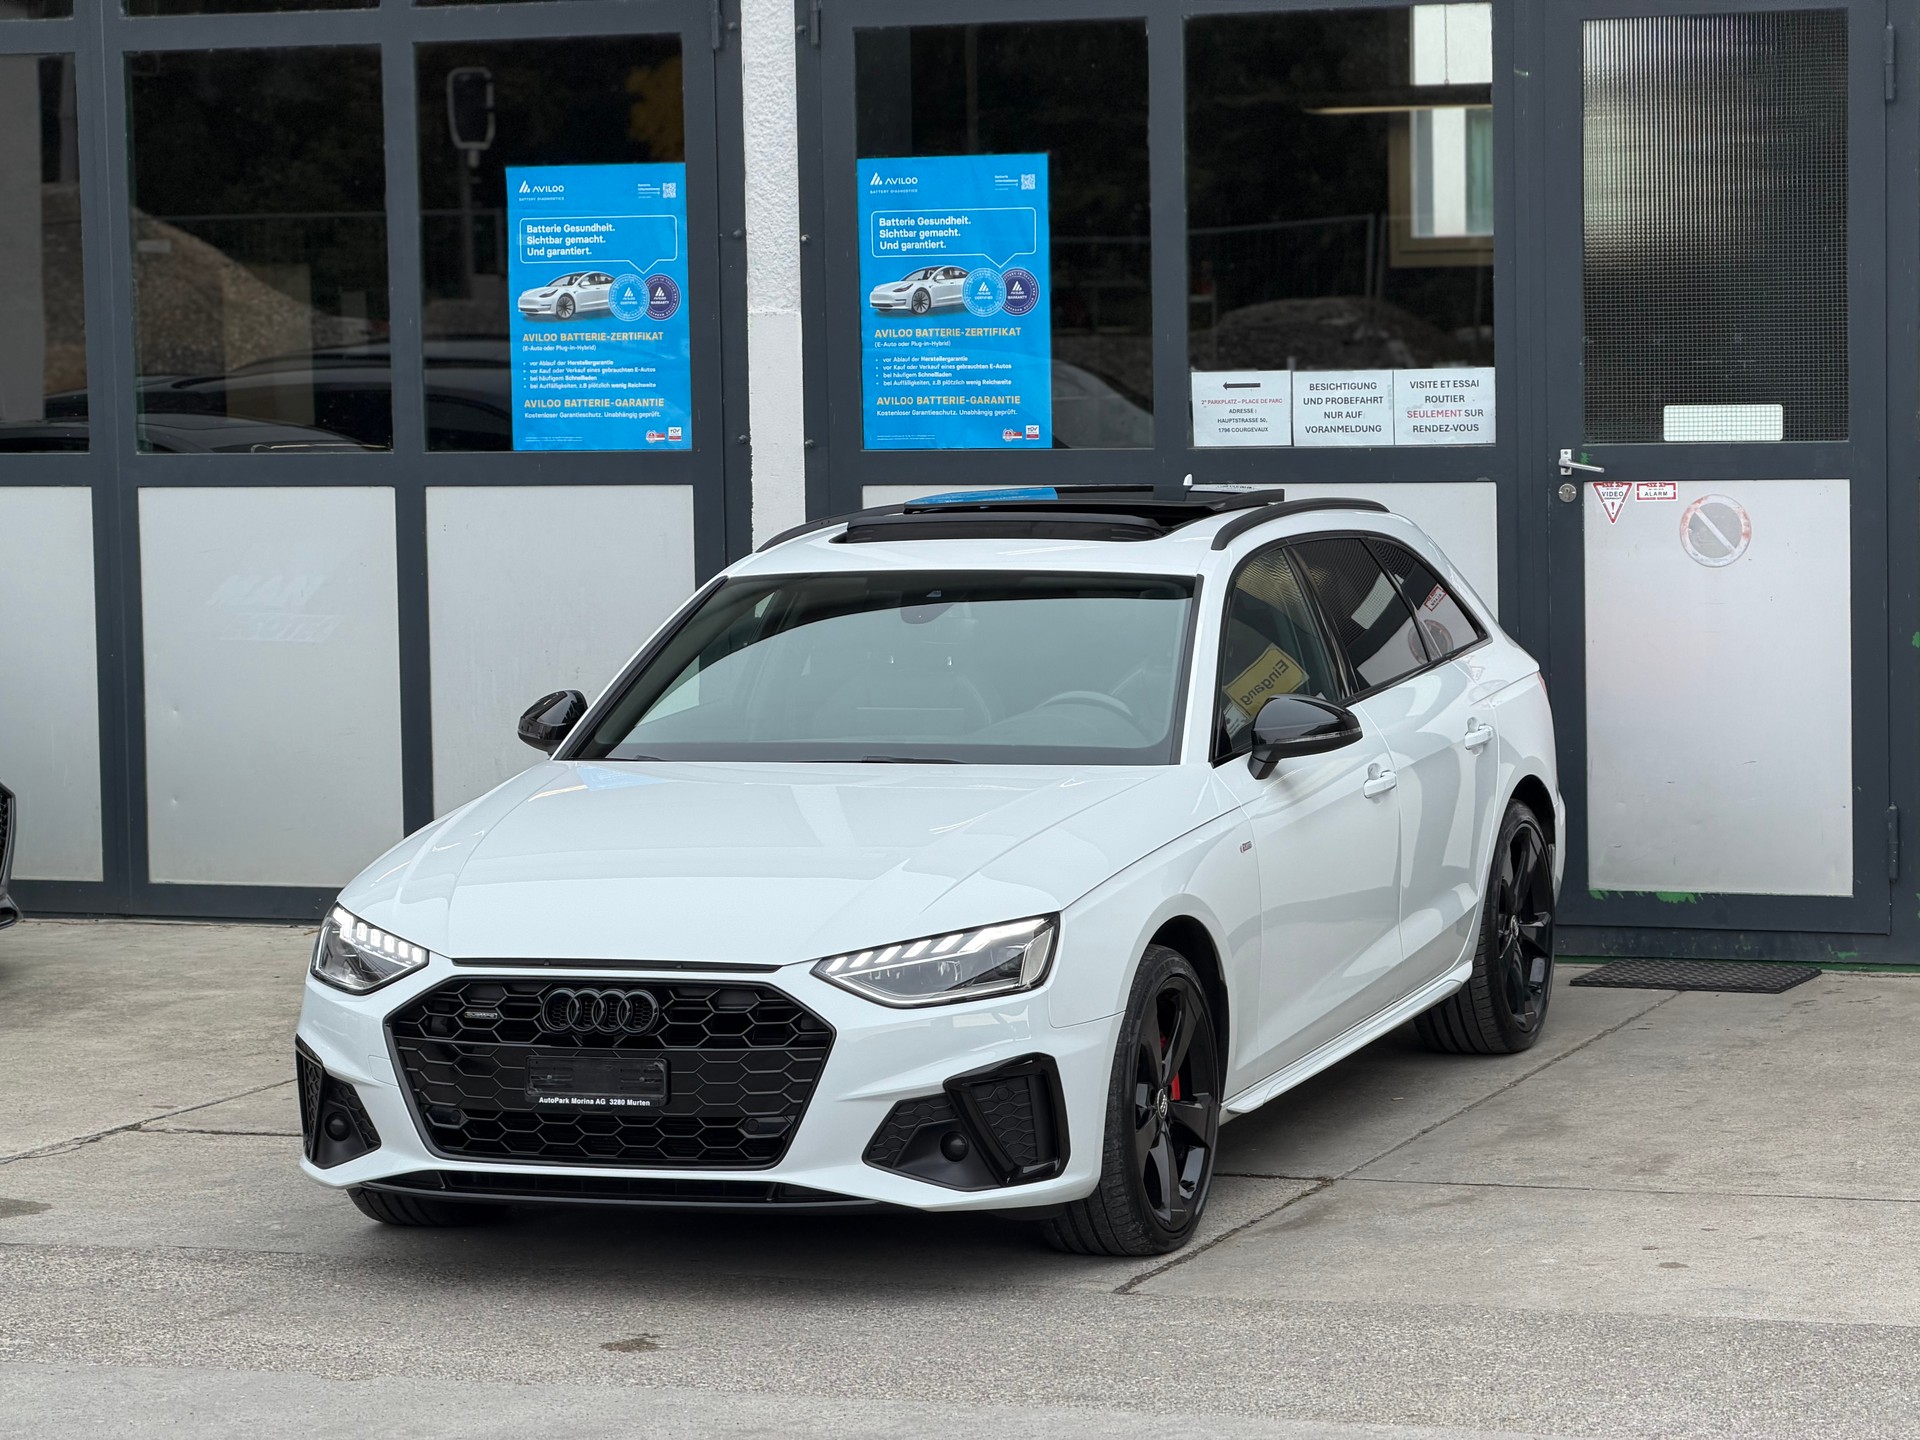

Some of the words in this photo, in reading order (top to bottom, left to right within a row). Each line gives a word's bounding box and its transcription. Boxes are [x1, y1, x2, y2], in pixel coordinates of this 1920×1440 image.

[885, 177, 918, 185] AVILOO
[532, 185, 565, 193] AVILOO
[879, 217, 915, 226] Batterie
[918, 216, 971, 225] Gesundheit.
[527, 225, 561, 233] Batterie
[564, 223, 615, 233] Gesundheit.
[879, 229, 917, 238] Sichtbar
[919, 228, 961, 239] gemacht.
[527, 236, 563, 244] Sichtbar
[565, 235, 606, 246] gemacht.
[879, 241, 899, 250] Und
[901, 240, 947, 251] garantiert.
[527, 247, 545, 256] Und
[547, 246, 592, 258] garantiert.
[523, 334, 557, 342] AVILOO
[560, 332, 664, 341] BATTERIE-ZERTIFIKAT
[875, 329, 913, 338] AVILOO
[916, 327, 1021, 337] BATTERIE-ZERTIFIKAT
[1309, 382, 1377, 391] BESICHTIGUNG
[1409, 380, 1439, 389] VISITE
[1440, 380, 1452, 388] ET
[1452, 379, 1480, 388] ESSAI
[524, 400, 561, 408] AVILOO
[564, 398, 664, 408] BATTERIE-GARANTIE
[876, 396, 914, 406] AVILOO
[917, 395, 1021, 405] BATTERIE-GARANTIE
[1303, 397, 1324, 405] UND
[1325, 396, 1385, 405] PROBEFAHRT
[1424, 394, 1466, 404] ROUTIER
[604, 411, 638, 419] Unabhängig
[639, 411, 661, 419] geprüft.
[959, 409, 993, 417] Unabhängig
[994, 408, 1018, 416] geprüft.
[1323, 410, 1344, 419] NUR
[1344, 410, 1363, 419] AUF
[1406, 409, 1463, 419] SEULEMENT
[1464, 408, 1484, 418] SUR
[1304, 424, 1383, 434] VORANMELDUNG
[1412, 423, 1480, 433] RENDEZ-VOUS
[539, 1096, 570, 1104] AutoPark
[571, 1097, 595, 1105] Morina
[609, 1098, 626, 1106] 3280
[626, 1098, 651, 1106] Murten
